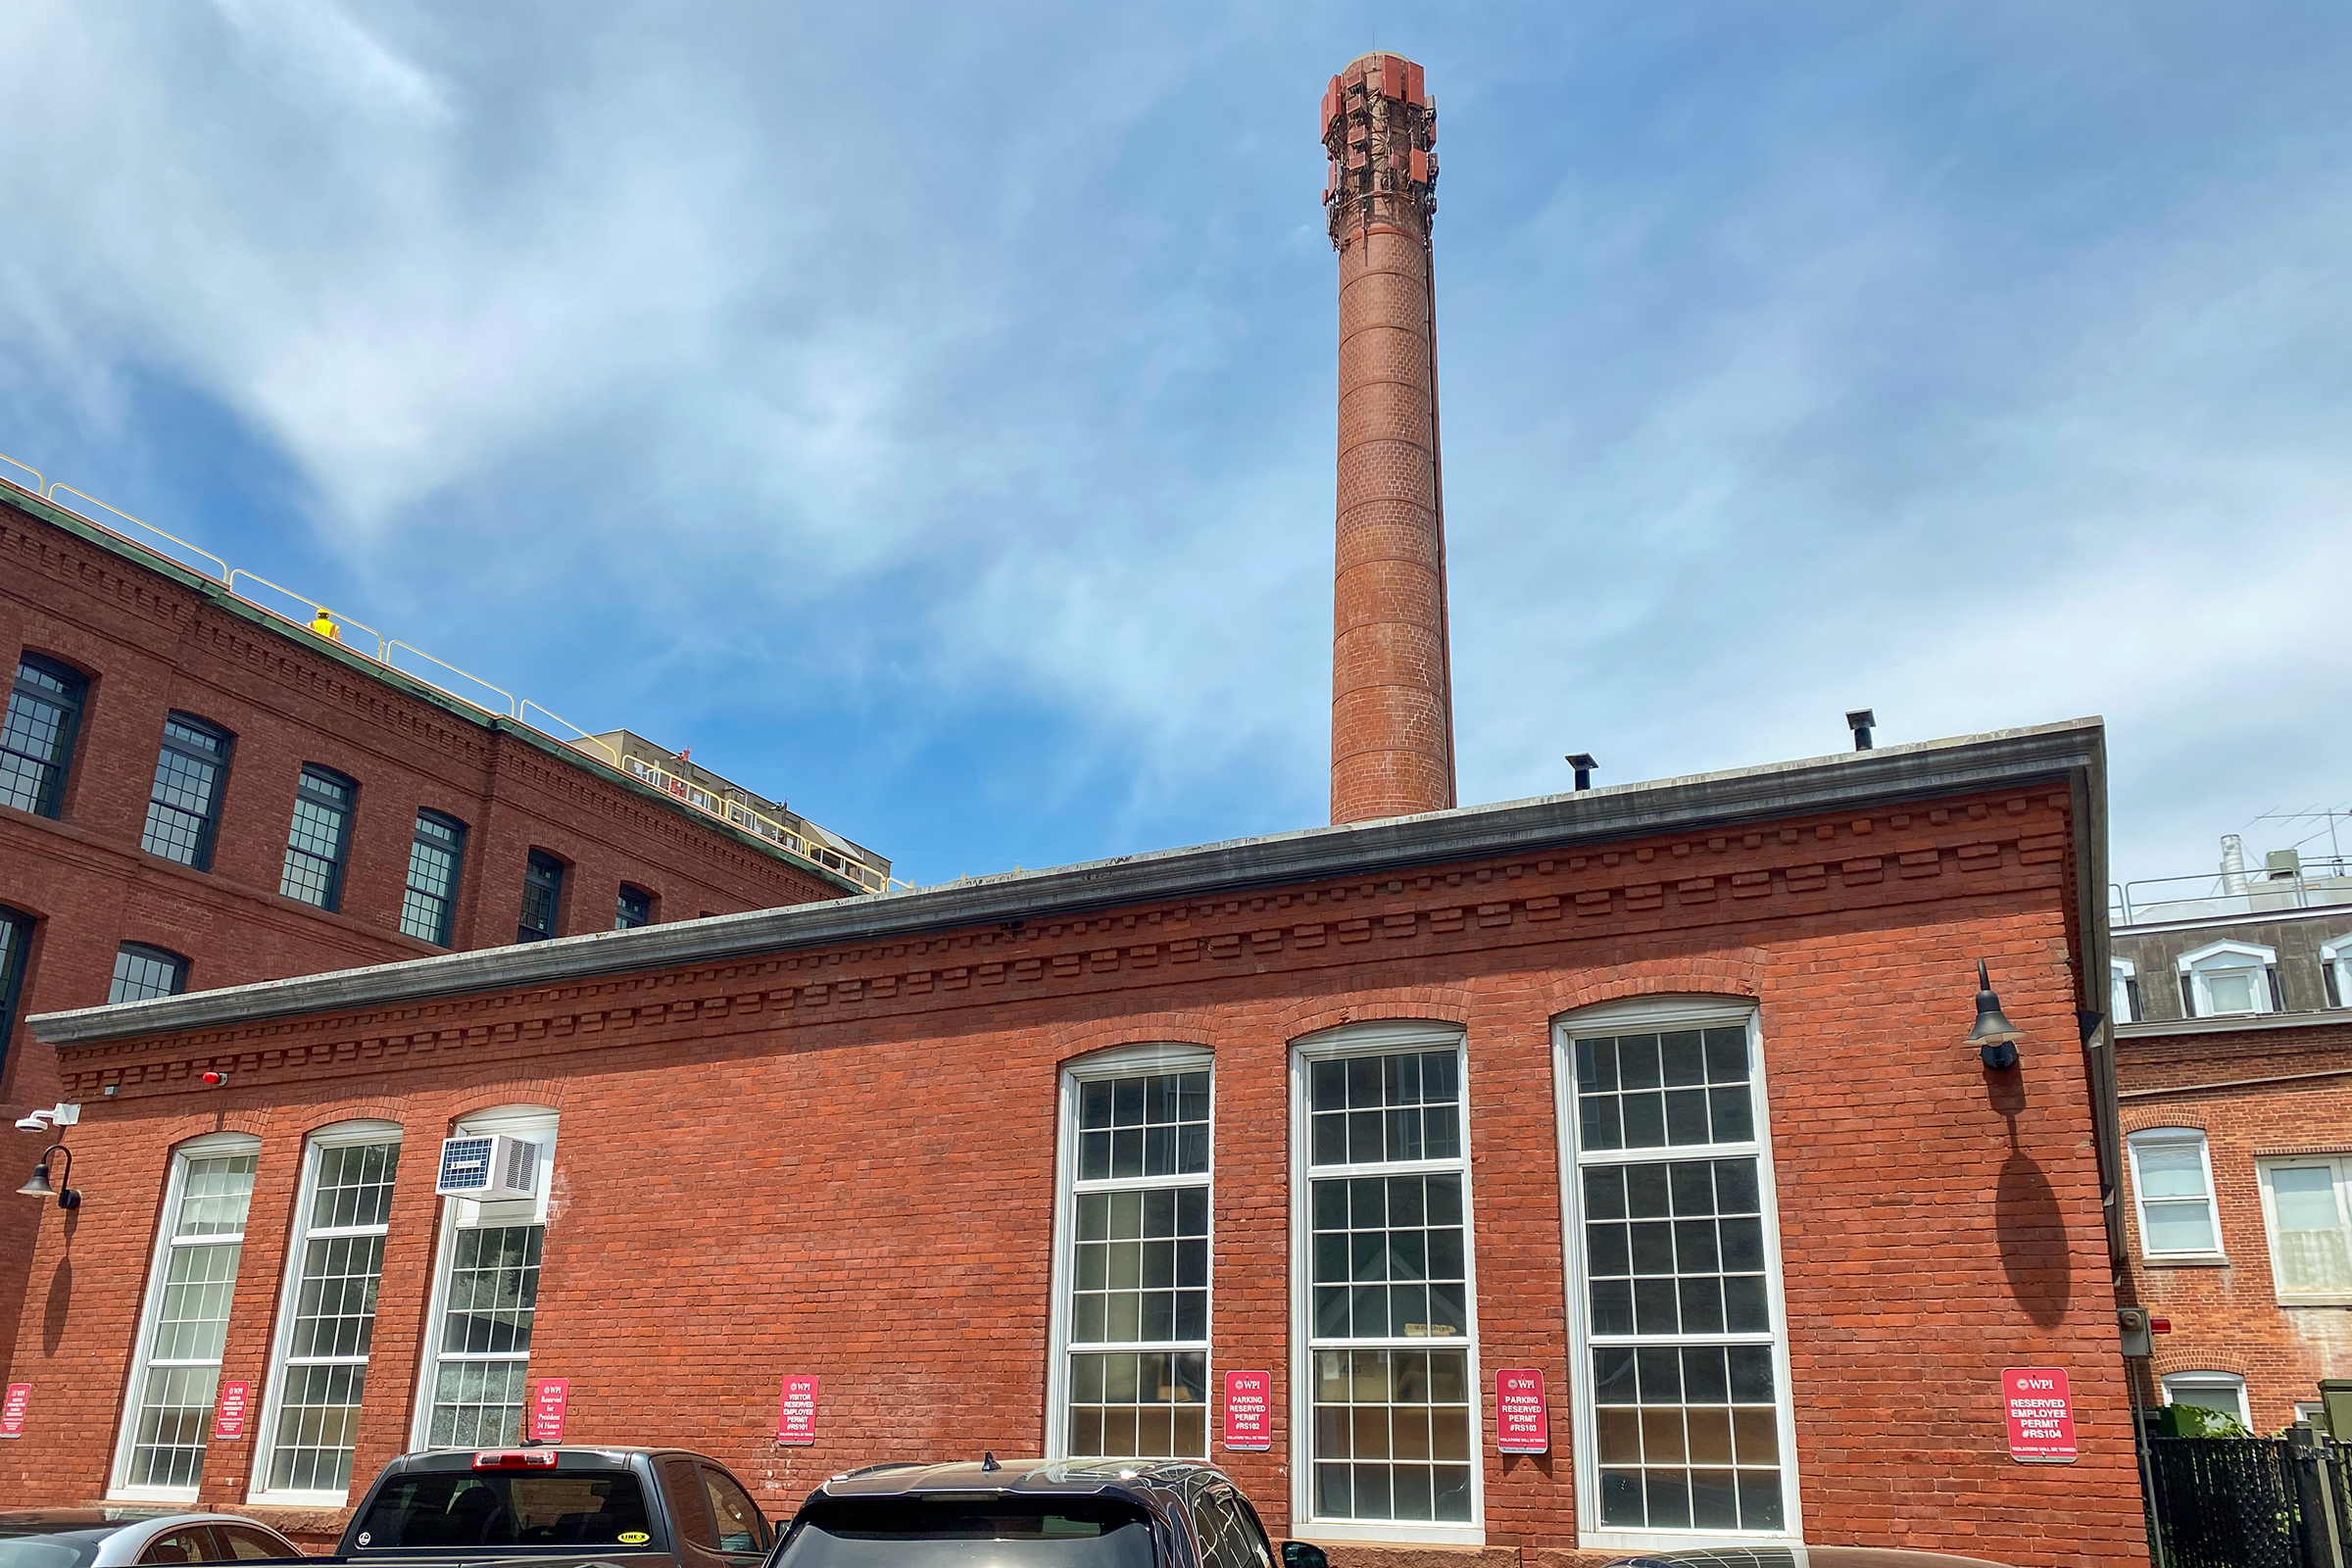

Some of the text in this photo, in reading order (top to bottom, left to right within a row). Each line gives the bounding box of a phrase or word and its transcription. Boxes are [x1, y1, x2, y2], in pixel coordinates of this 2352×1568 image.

[1244, 1381, 1260, 1390] WPI
[1518, 1380, 1536, 1389] WPI
[2029, 1379, 2054, 1390] WPI
[1504, 1396, 1539, 1404] PARKING
[2010, 1398, 2066, 1408] RESERVED
[1501, 1404, 1543, 1413] RESERVED
[2011, 1409, 2068, 1418] EMPLOYEE
[1508, 1414, 1538, 1423] PERMIT
[1509, 1424, 1538, 1433] #RS103
[2021, 1419, 2060, 1429] PERMIT
[2022, 1430, 2063, 1439] #RS104
